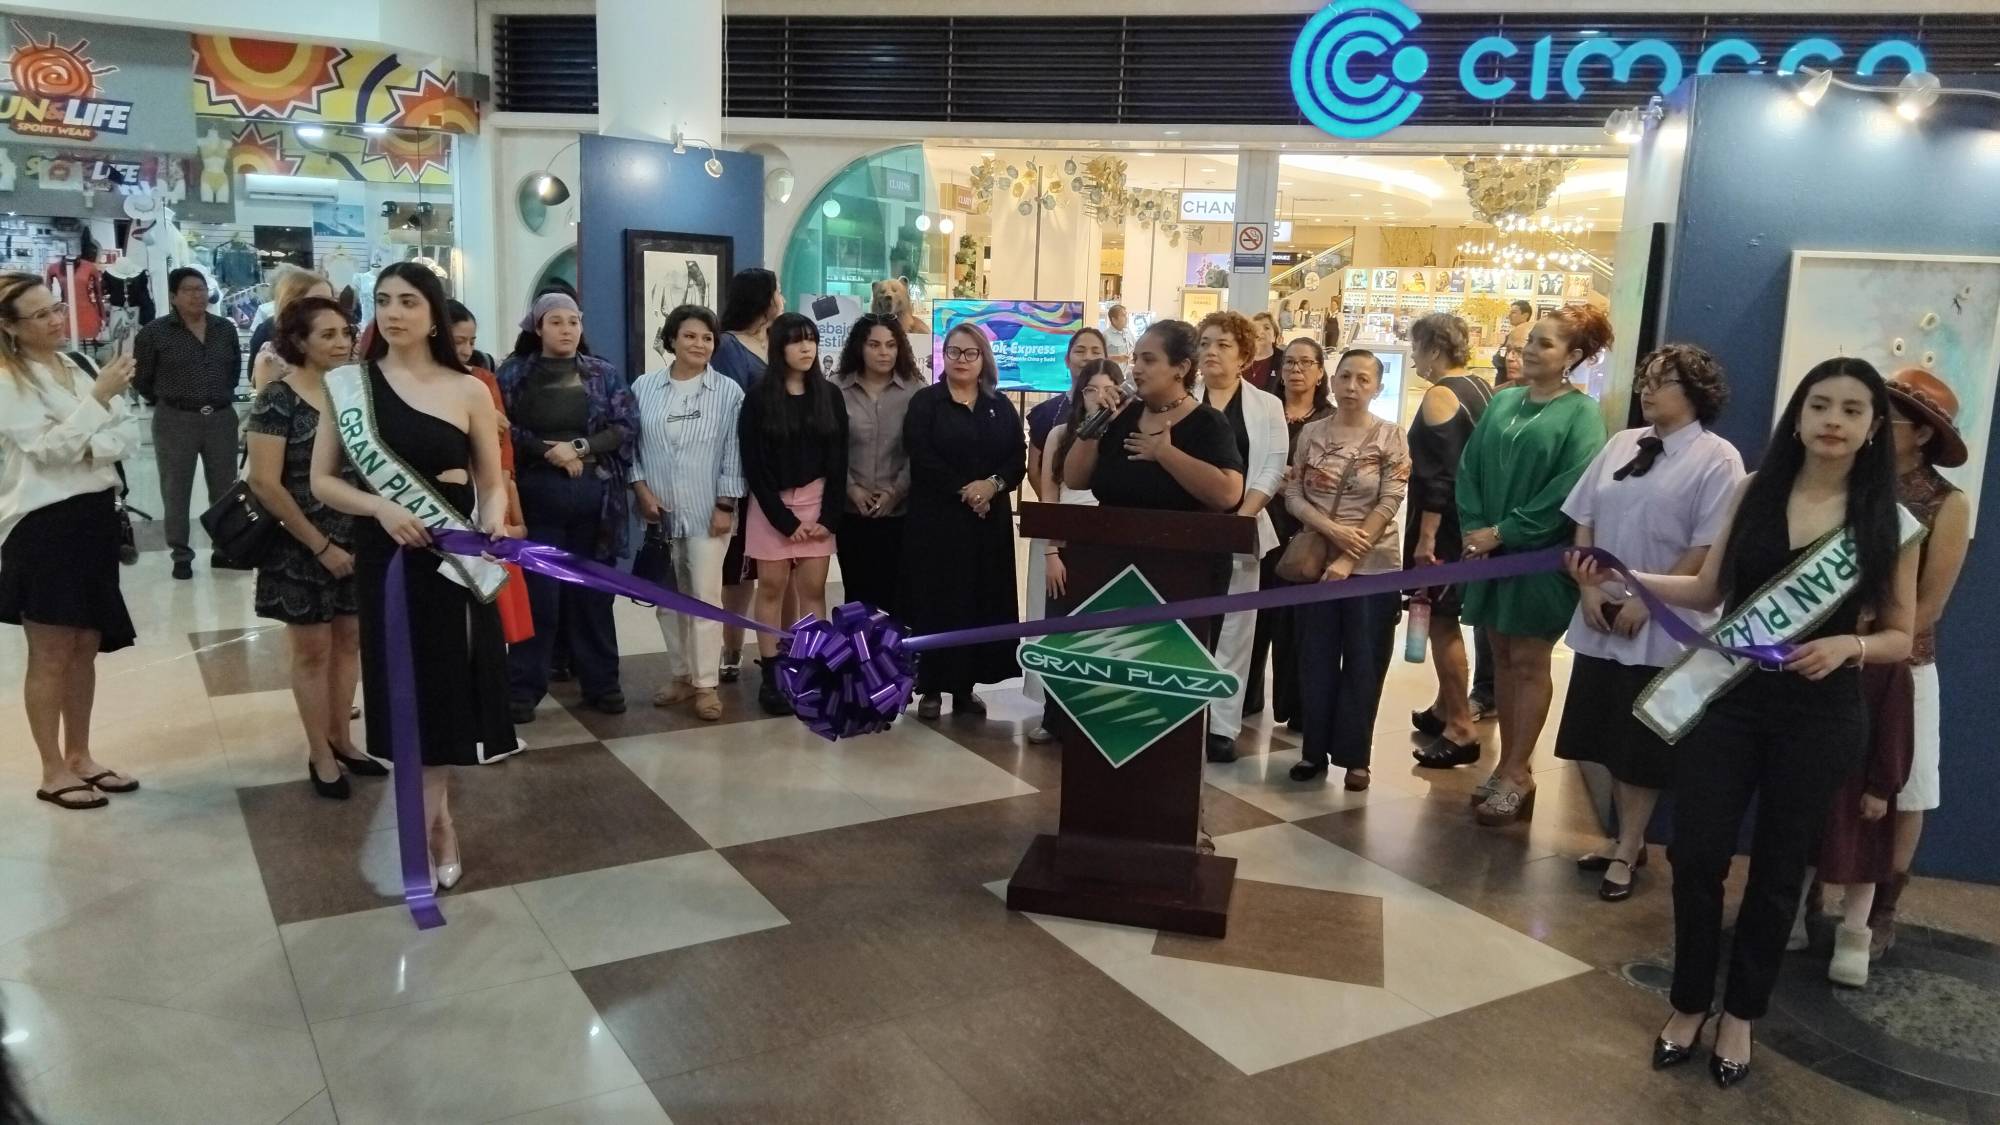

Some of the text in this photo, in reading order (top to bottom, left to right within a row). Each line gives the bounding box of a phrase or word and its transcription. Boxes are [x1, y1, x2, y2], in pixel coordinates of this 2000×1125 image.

[63, 98, 131, 129] LIFE
[17, 122, 91, 137] SPORT WEAR
[990, 341, 1055, 356] ok Express
[340, 407, 387, 476] GRAN
[1022, 650, 1233, 695] GRAN PLAZA
